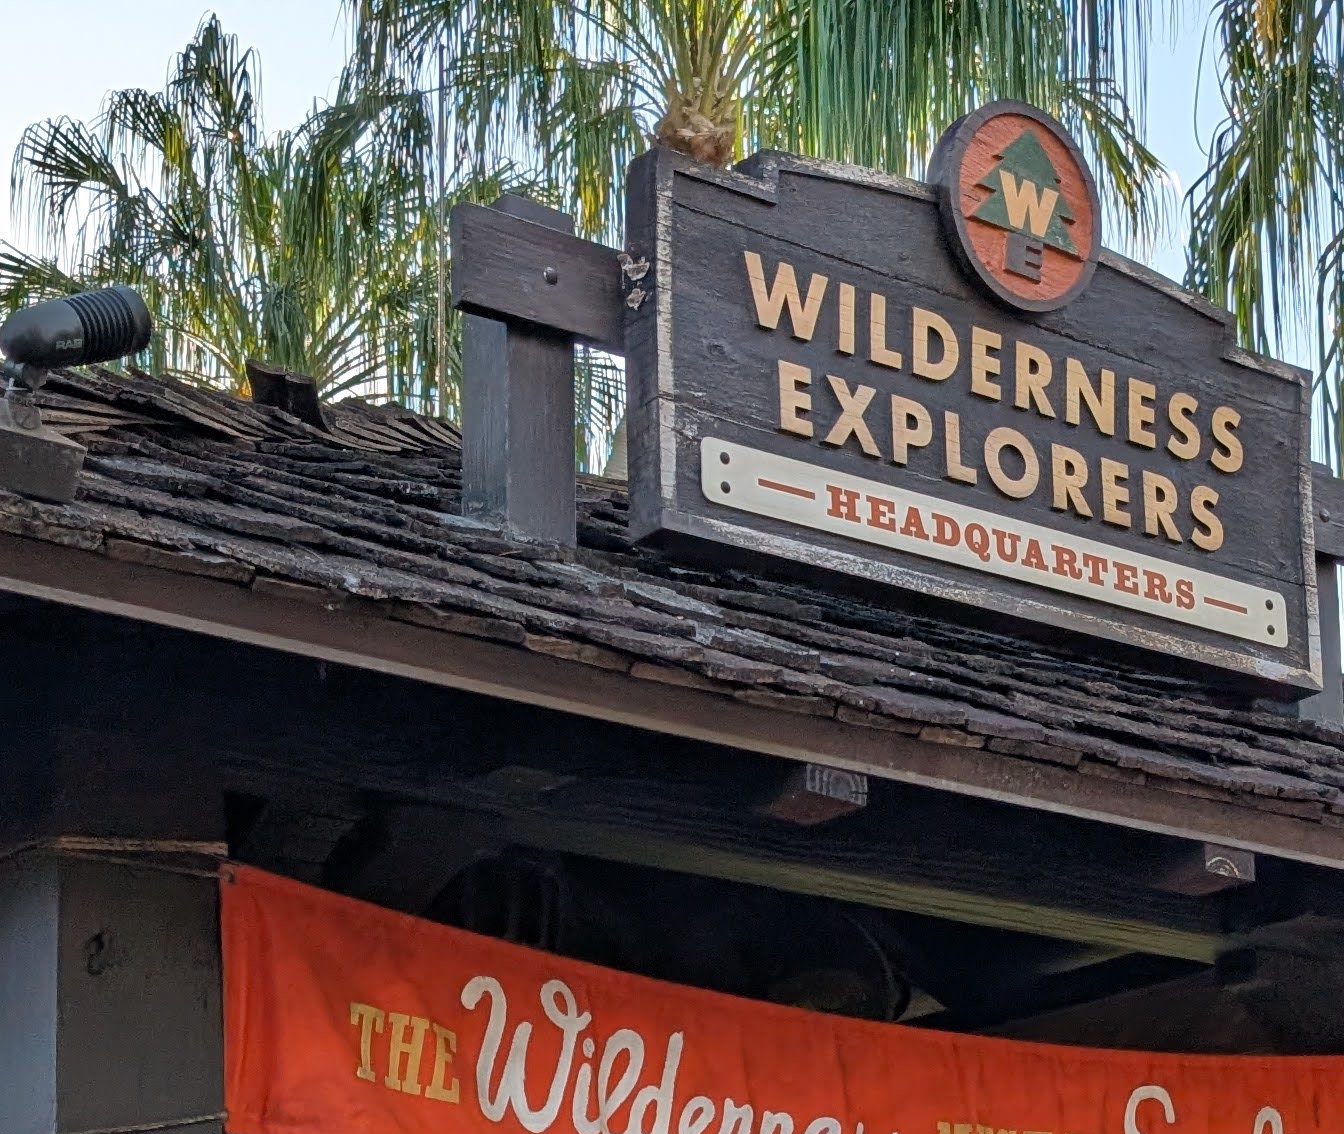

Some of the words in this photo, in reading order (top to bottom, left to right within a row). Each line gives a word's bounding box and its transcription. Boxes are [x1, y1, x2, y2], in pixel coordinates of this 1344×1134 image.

[744, 250, 1244, 474] WILDERNESS
[778, 359, 1225, 552] EXPLORERS
[825, 484, 1197, 611] HEADQUARTERS
[349, 1002, 460, 1104] THE
